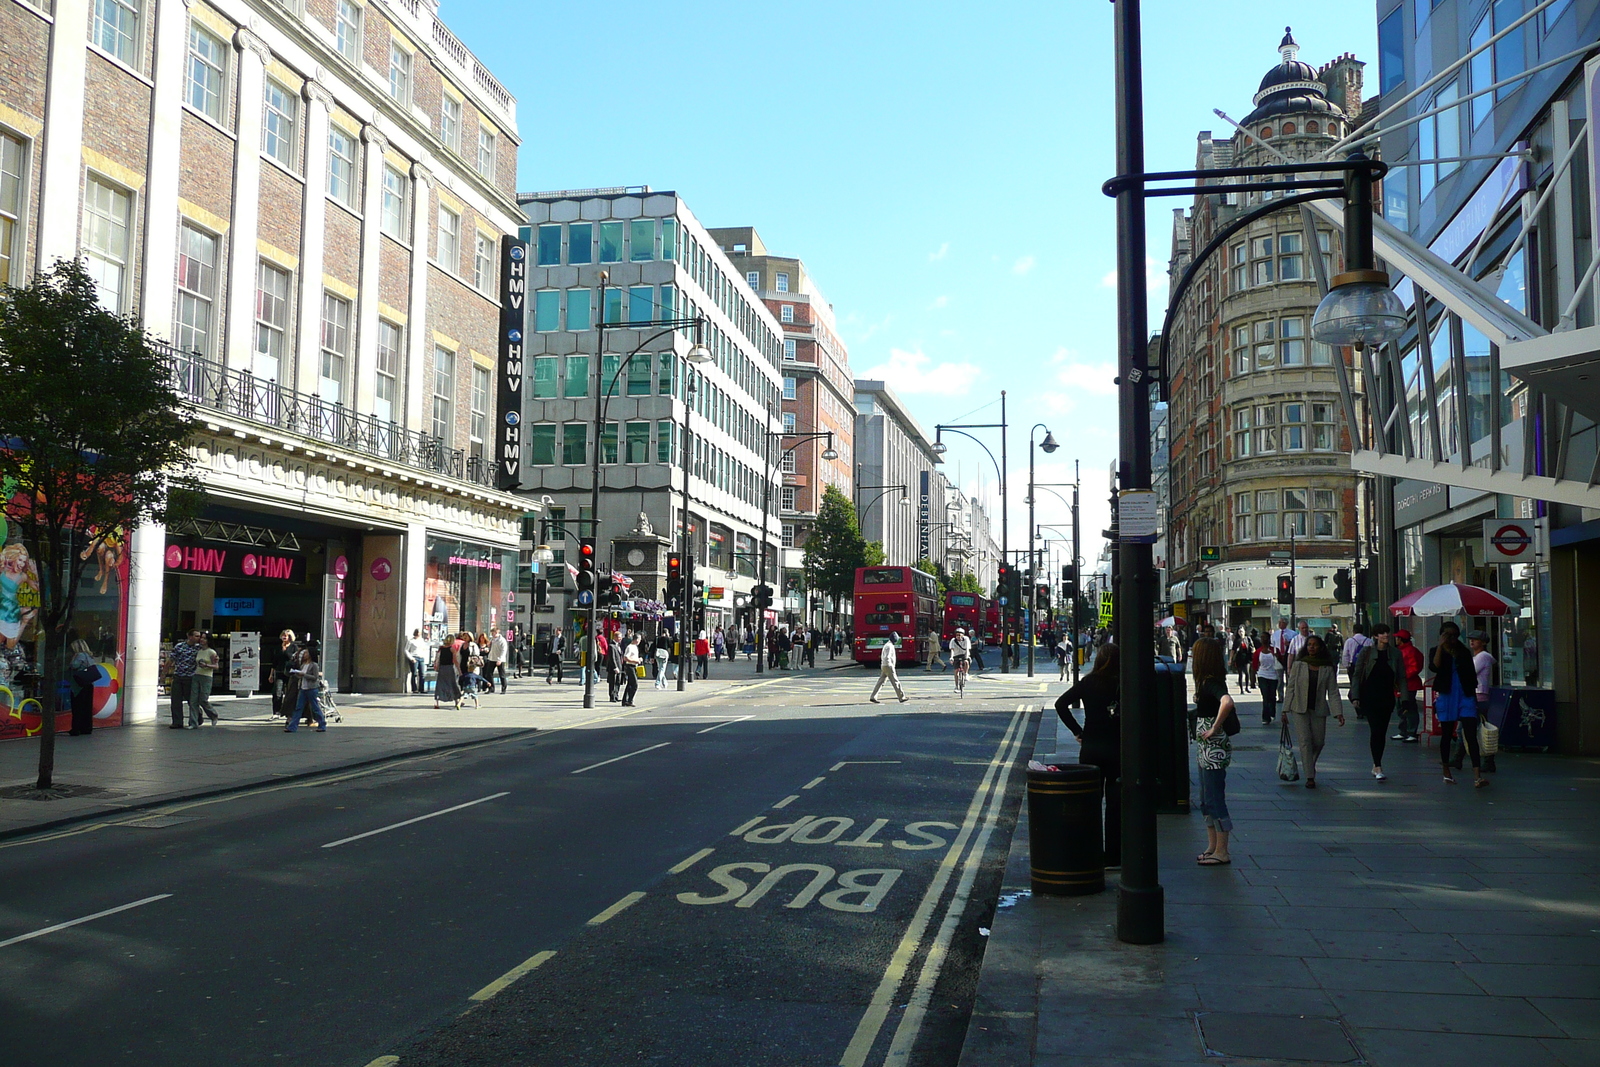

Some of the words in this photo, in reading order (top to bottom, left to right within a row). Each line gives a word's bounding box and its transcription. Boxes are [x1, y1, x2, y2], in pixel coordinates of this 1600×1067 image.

[508, 262, 523, 309] HMV
[506, 344, 521, 392] HMV
[504, 427, 519, 475] HMV
[1420, 484, 1441, 500] PERKINS
[920, 494, 929, 560] DEBENHAM
[182, 546, 227, 573] HMV
[256, 555, 294, 579] HMV
[1226, 577, 1253, 592] Jones
[224, 600, 255, 611] digital
[333, 582, 346, 639] HMV
[744, 815, 960, 850] STOP
[676, 862, 903, 913] BUS
